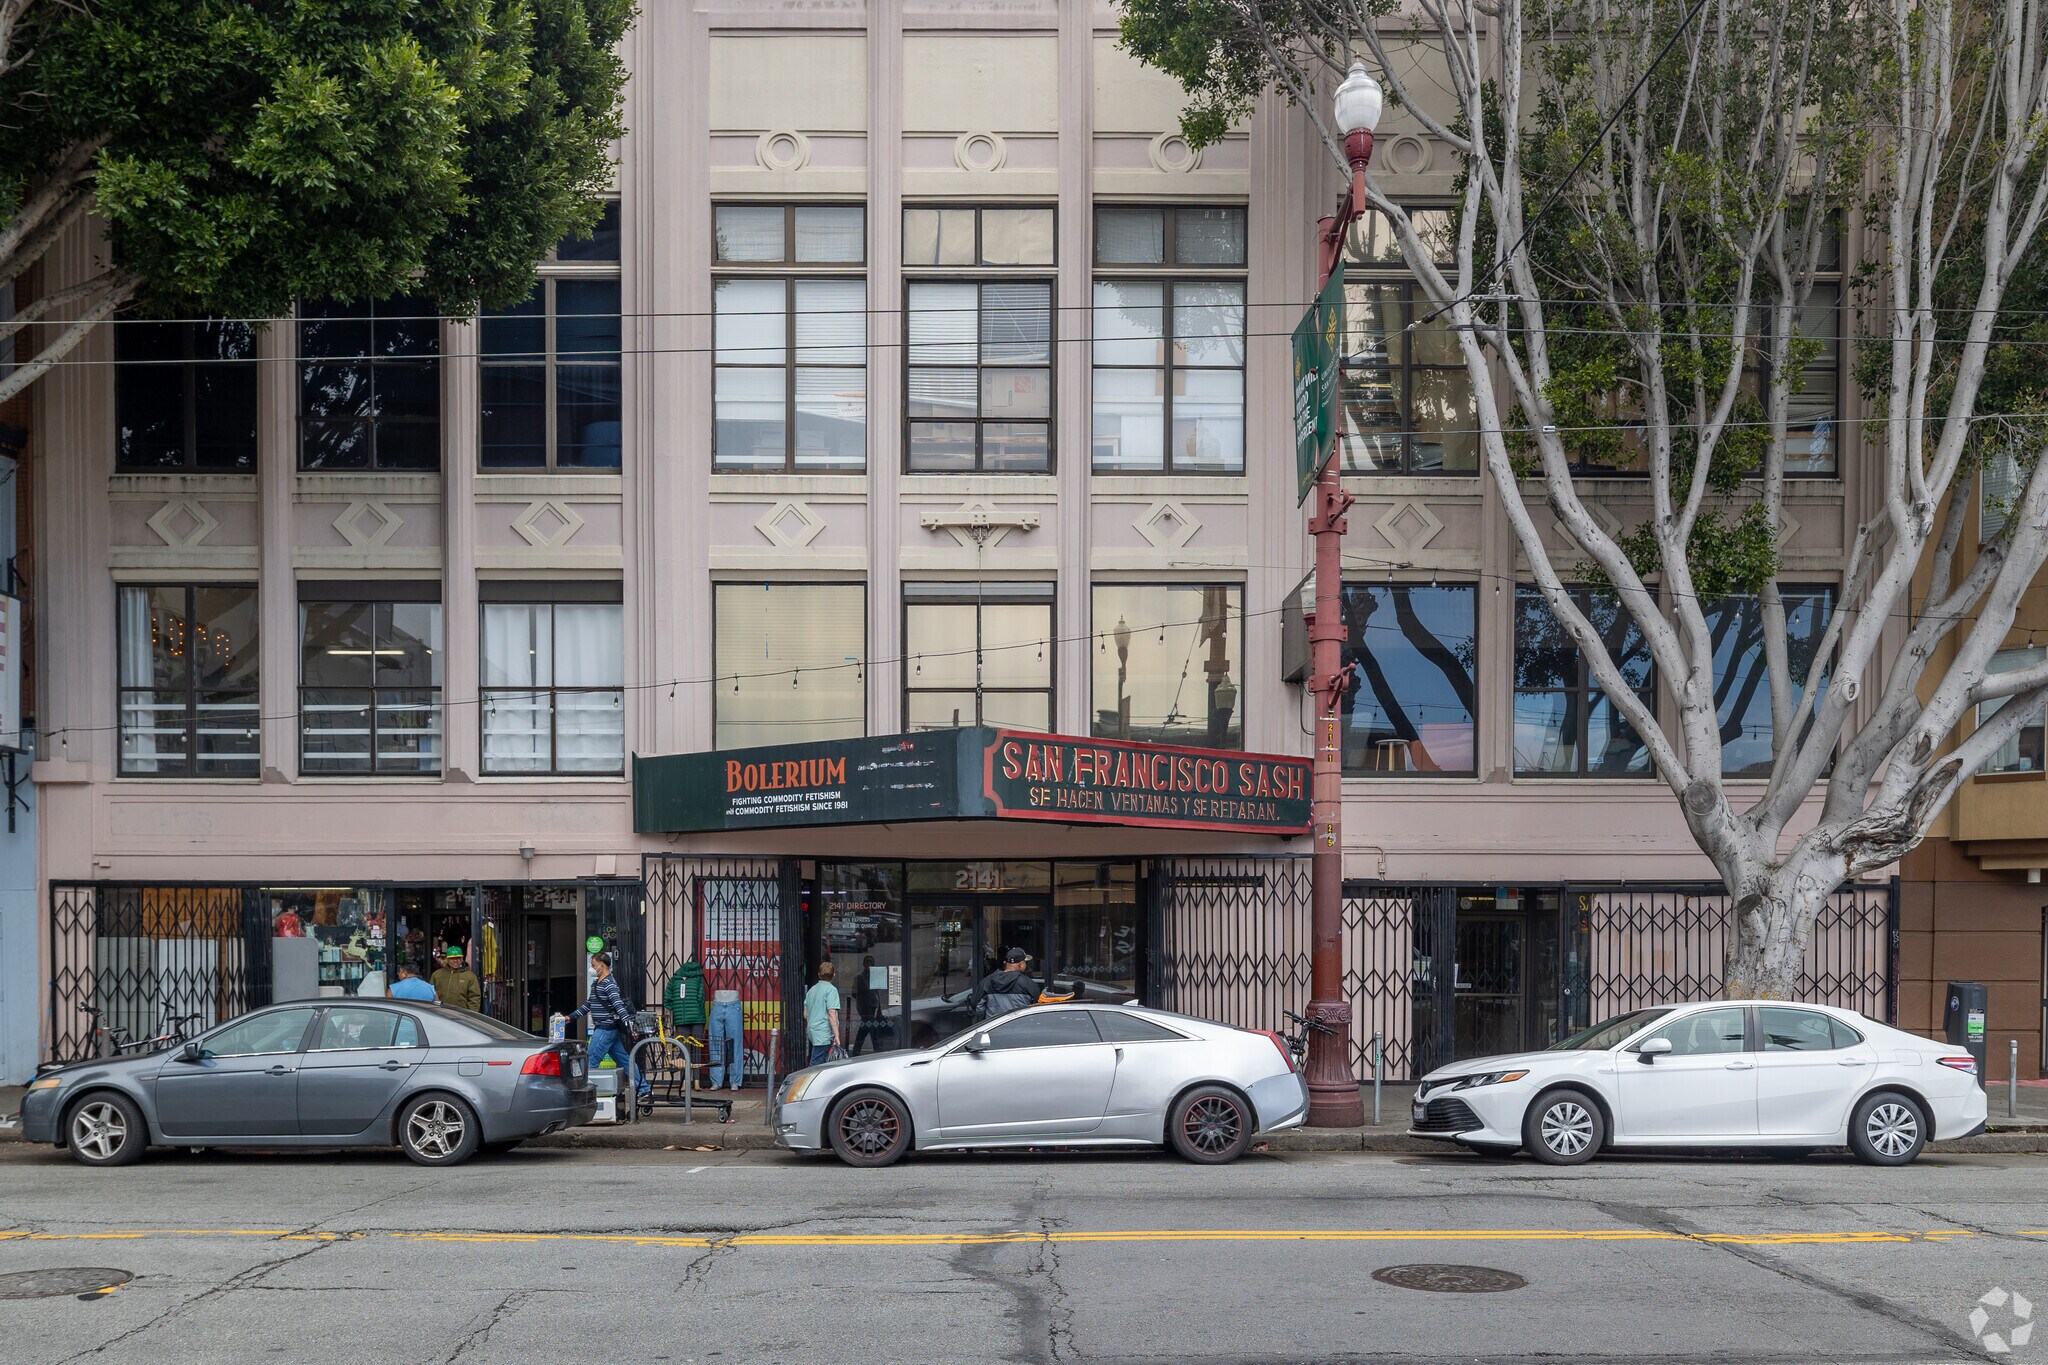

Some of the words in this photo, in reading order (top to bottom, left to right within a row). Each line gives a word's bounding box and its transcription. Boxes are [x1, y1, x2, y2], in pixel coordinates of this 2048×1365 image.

[726, 757, 847, 793] BOLERIUM
[1002, 741, 1063, 783] SAN
[1073, 747, 1229, 795] FRANCISCO
[1238, 762, 1304, 800] SASH
[732, 796, 762, 806] FIGHTING
[763, 793, 803, 804] COMMODITY
[805, 791, 841, 801] FETISHISM
[1029, 787, 1051, 807] SE
[1056, 788, 1104, 811] HACEN
[1110, 791, 1178, 815] VENTANAS
[1183, 798, 1190, 816] Y
[1193, 799, 1208, 817] SE
[1210, 800, 1281, 821] REPARAN.
[735, 805, 774, 816] COMMODITY
[775, 803, 811, 813] FETISHISM
[812, 802, 832, 811] SINCE
[834, 801, 848, 810] 1981
[955, 869, 1001, 889] 2141
[829, 902, 844, 910] 2141
[847, 901, 887, 910] DIRECTORY
[743, 1007, 780, 1024] ektra
